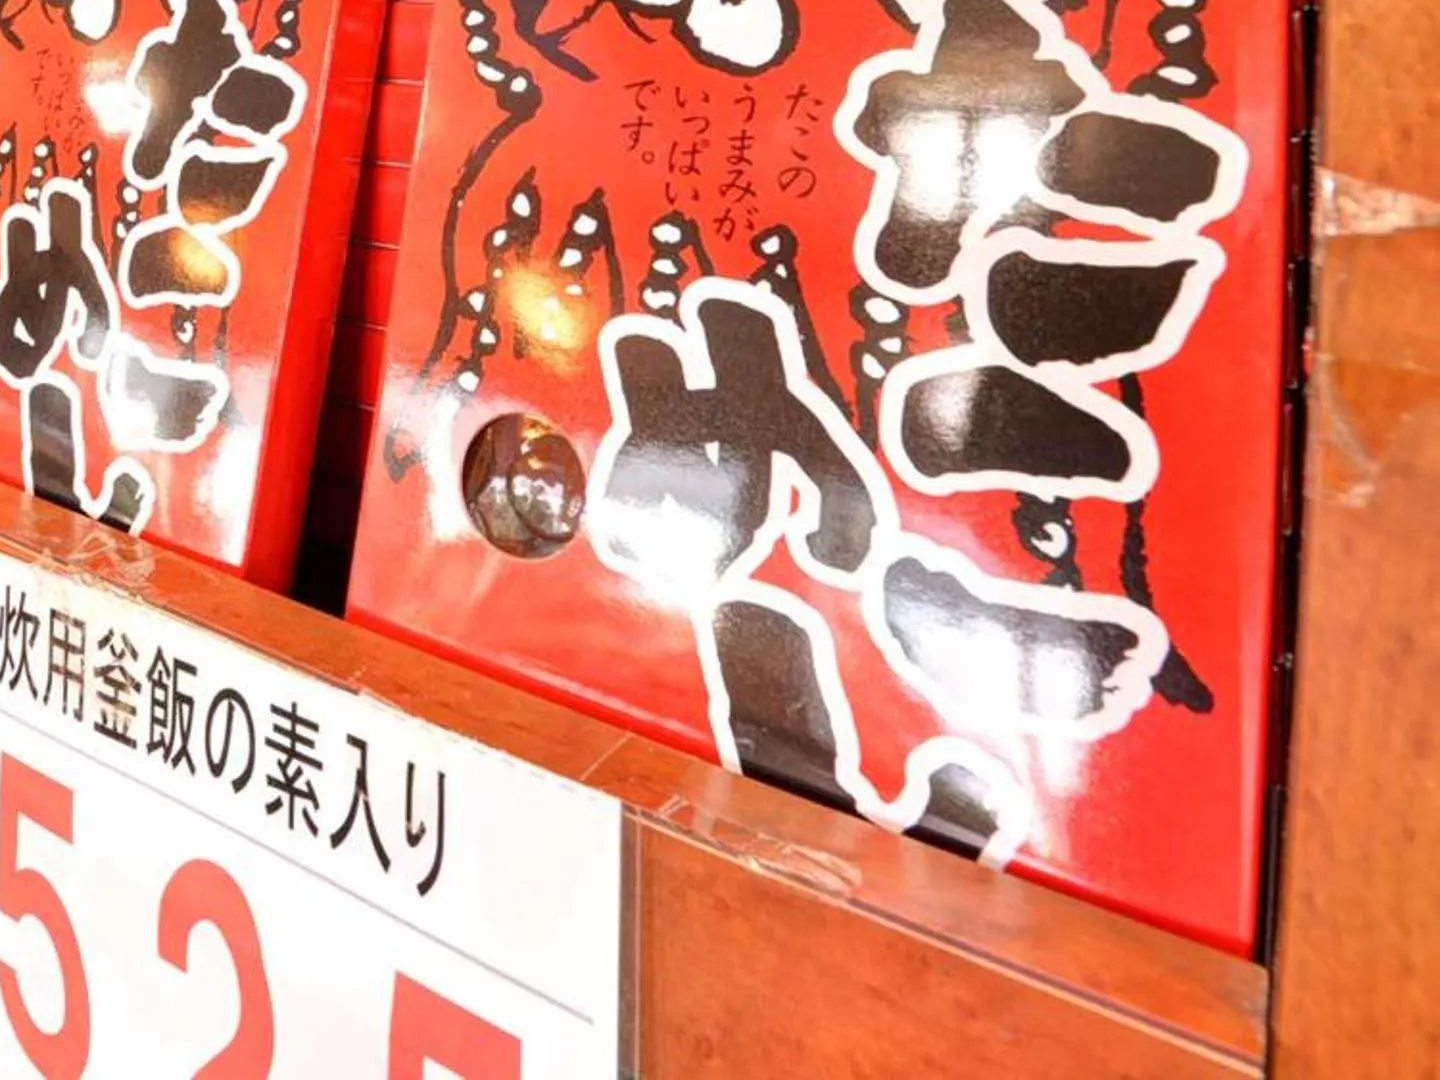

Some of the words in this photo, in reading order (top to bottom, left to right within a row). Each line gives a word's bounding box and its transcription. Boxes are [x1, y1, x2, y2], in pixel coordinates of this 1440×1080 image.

[620, 79, 661, 164] です。
[664, 86, 710, 206] いっぱい
[713, 83, 759, 242] うまみが
[777, 83, 823, 198] たこの
